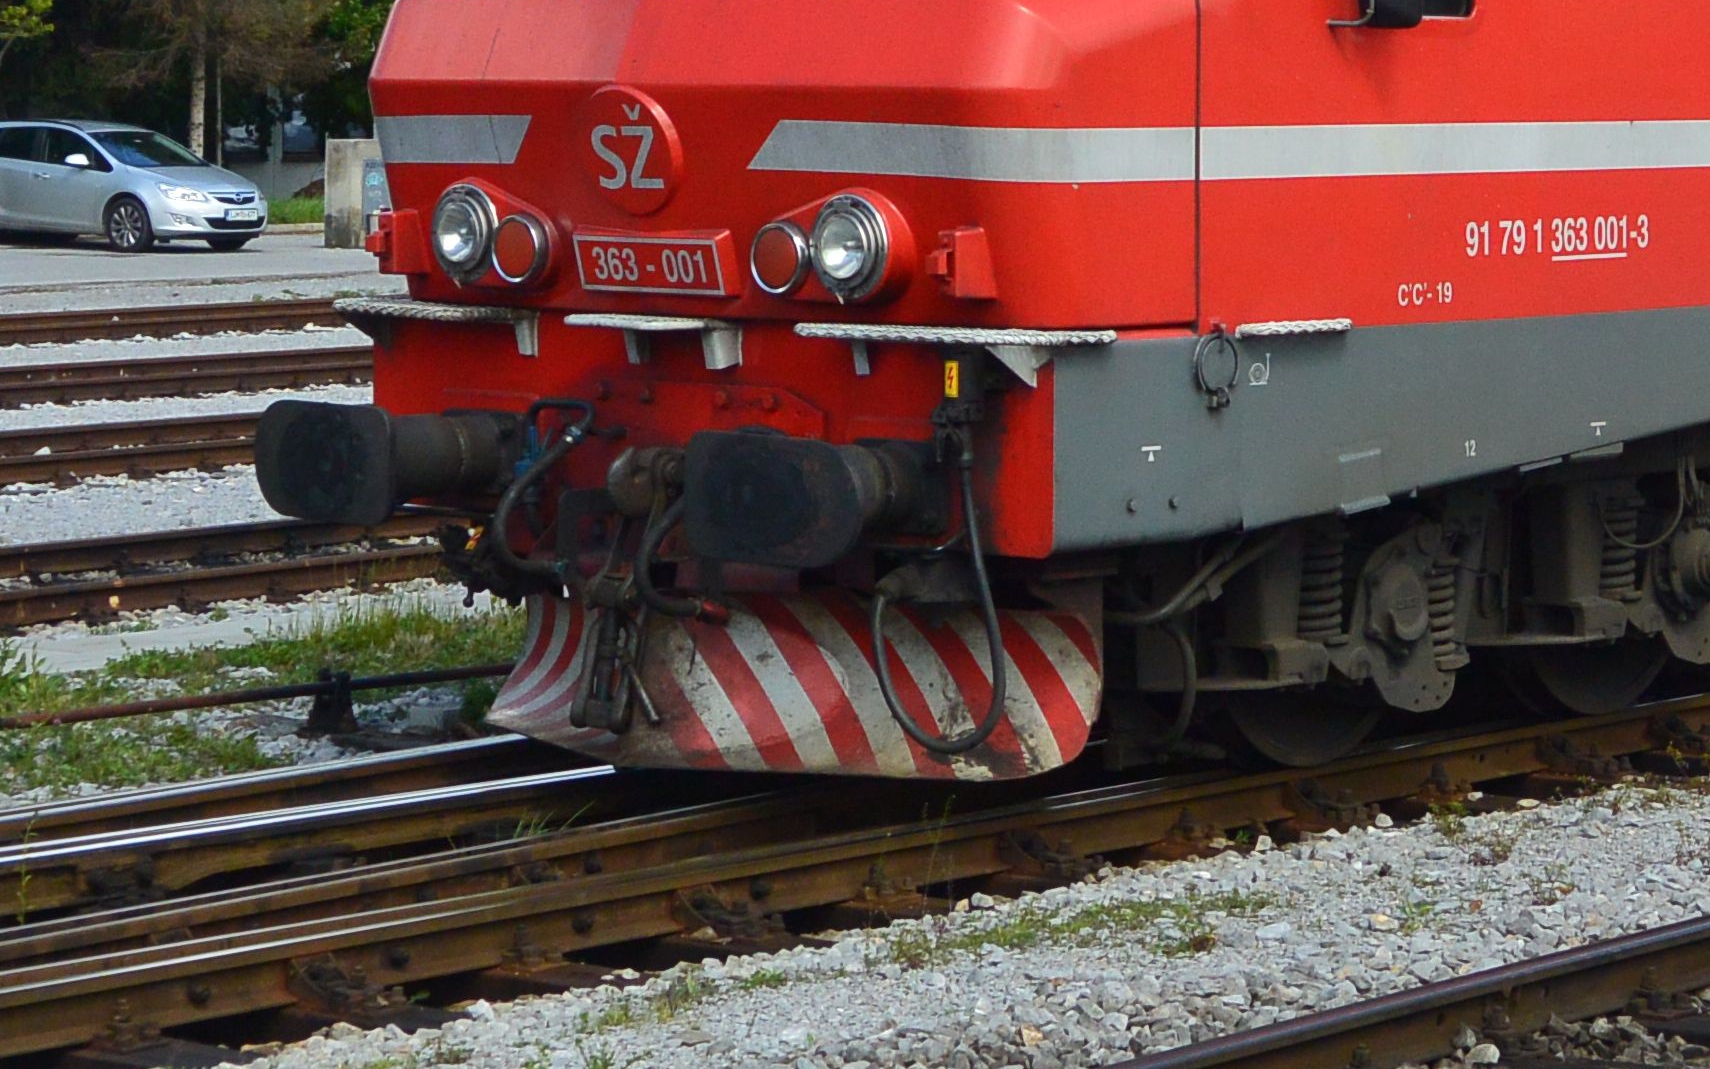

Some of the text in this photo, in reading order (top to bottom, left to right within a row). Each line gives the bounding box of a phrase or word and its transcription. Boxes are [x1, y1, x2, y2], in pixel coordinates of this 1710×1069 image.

[591, 103, 665, 189] SŽ
[1465, 214, 1649, 257] 91 79 1 363 001-3
[592, 246, 639, 281] 363
[661, 249, 707, 283] 001
[1464, 439, 1477, 457] 12
